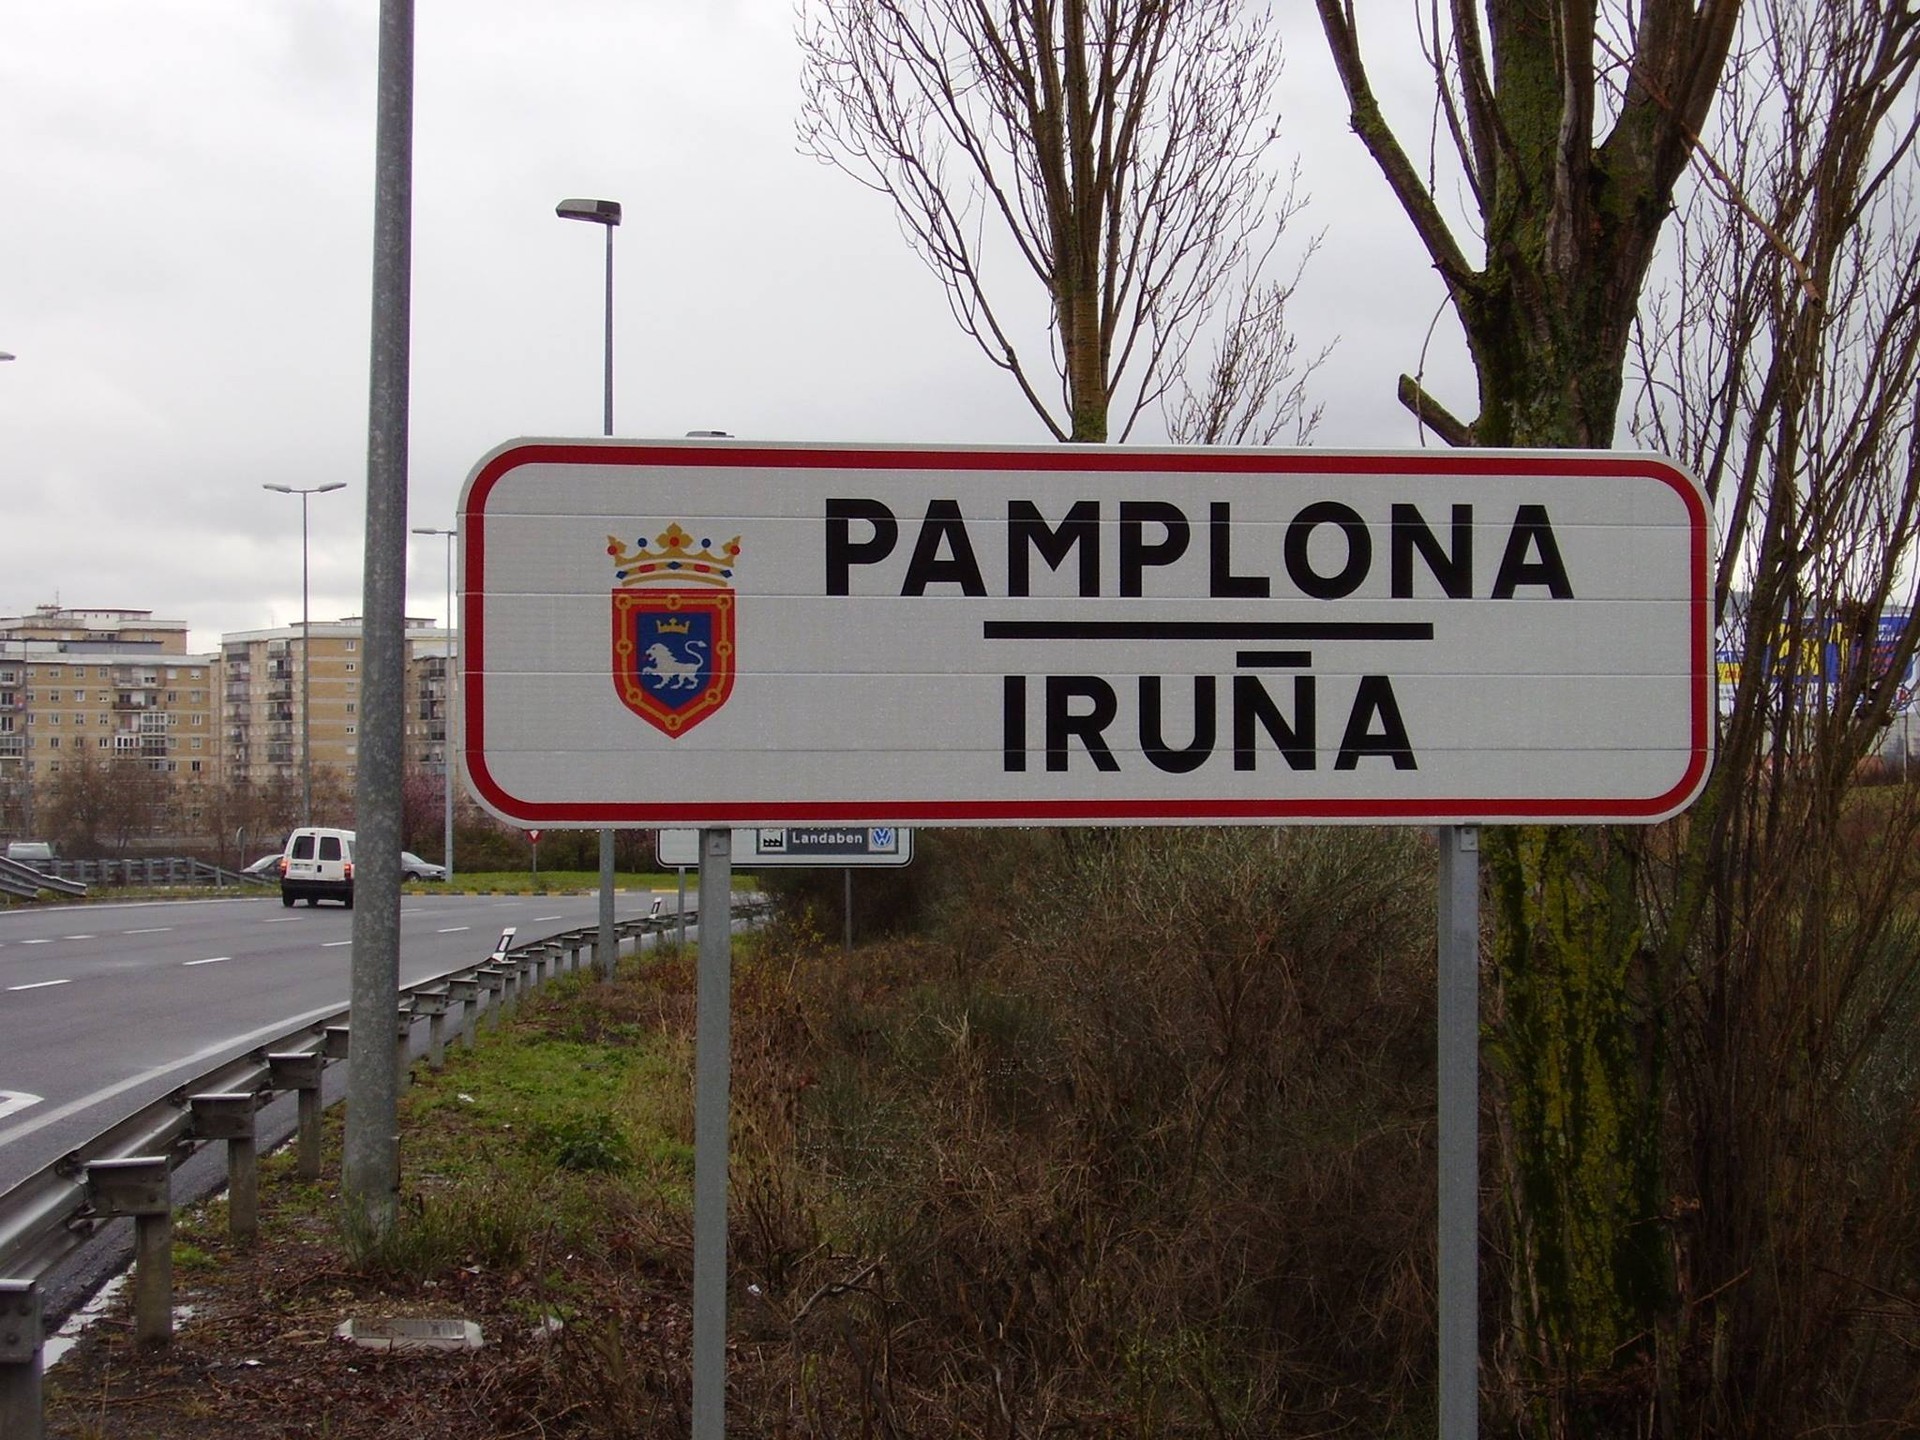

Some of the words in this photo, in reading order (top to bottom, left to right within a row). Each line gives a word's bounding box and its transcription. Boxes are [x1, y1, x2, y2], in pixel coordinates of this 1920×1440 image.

[826, 498, 1575, 600] PAMPLONA
[1003, 651, 1418, 773] IRUÑA
[792, 832, 863, 844] Landaben
